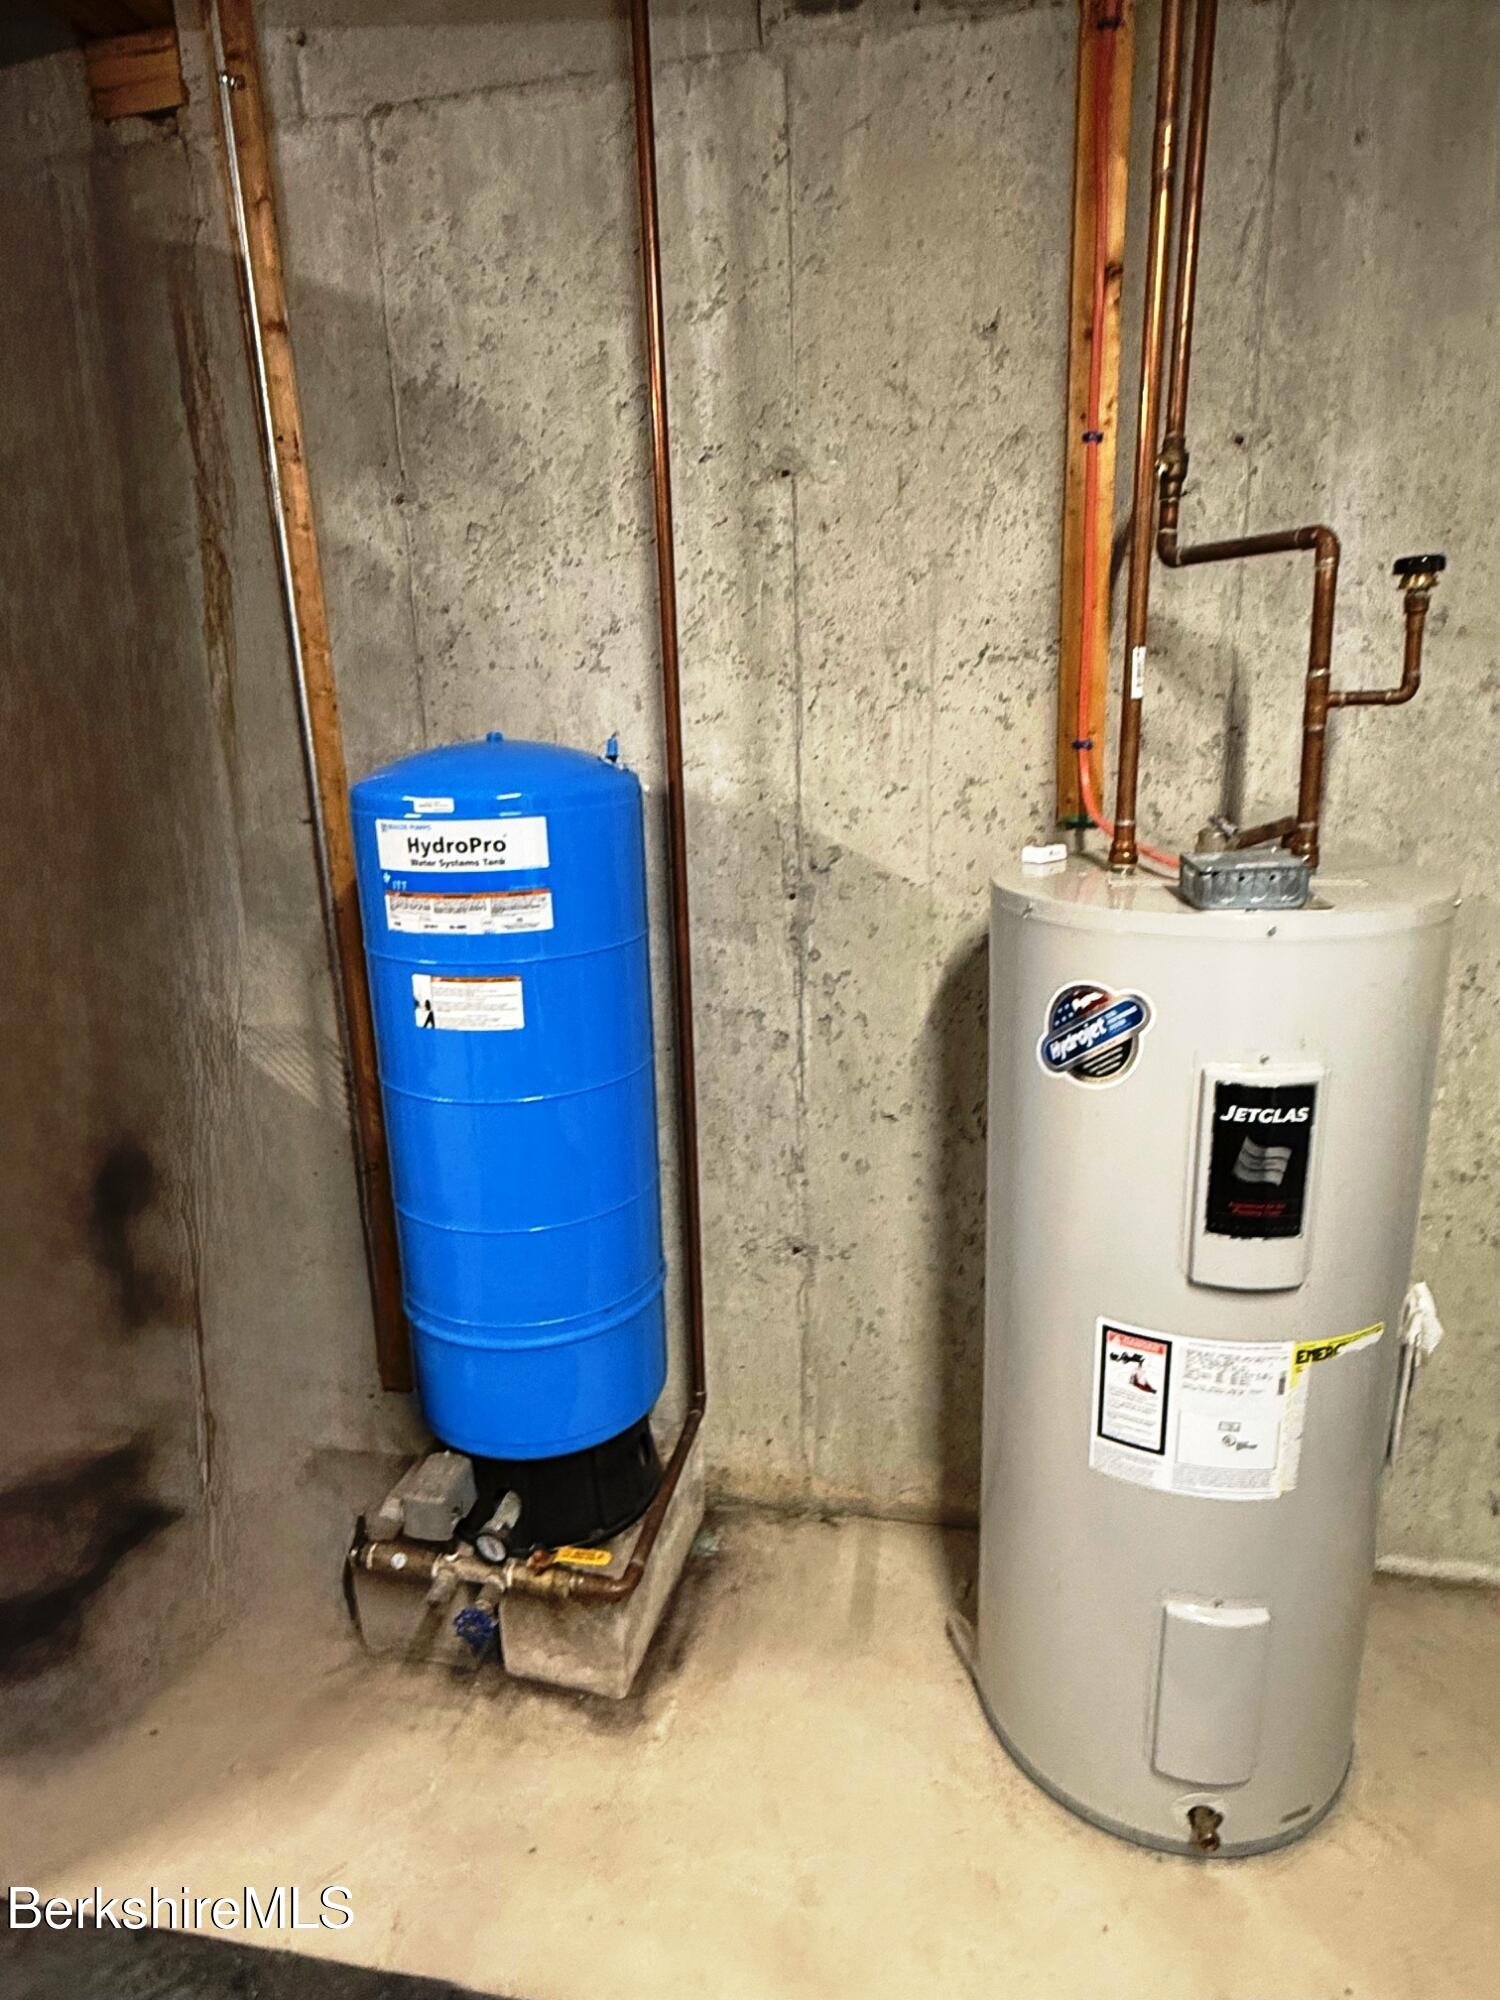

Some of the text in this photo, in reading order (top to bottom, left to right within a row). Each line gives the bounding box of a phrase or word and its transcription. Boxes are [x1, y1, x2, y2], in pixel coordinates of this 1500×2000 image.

[407, 836, 507, 858] HydroPro
[410, 858, 506, 869] Water Systems Tank
[1049, 1016, 1108, 1061] Hydrojet
[1219, 1104, 1310, 1124] JETGLAS
